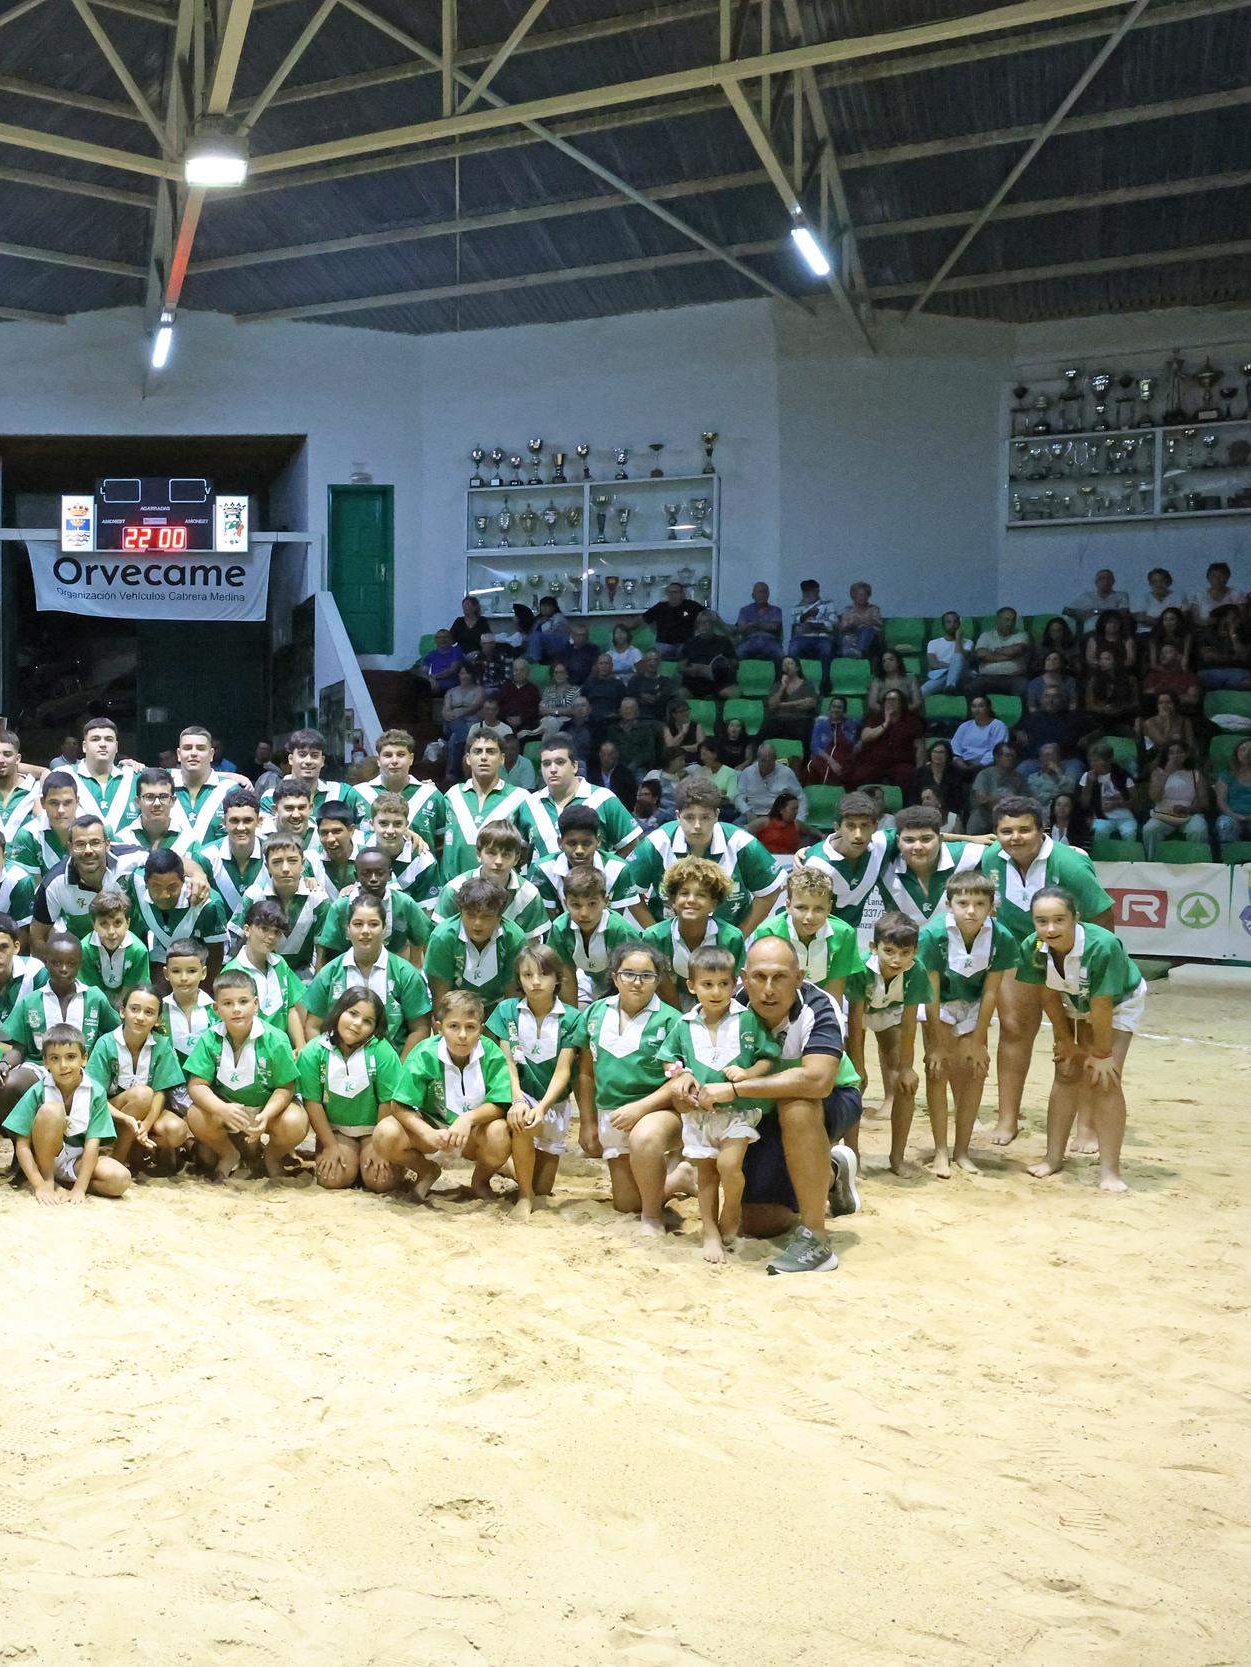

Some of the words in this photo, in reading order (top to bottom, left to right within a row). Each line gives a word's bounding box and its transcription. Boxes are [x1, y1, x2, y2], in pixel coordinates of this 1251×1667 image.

[204, 487, 211, 495] V
[52, 556, 247, 587] Orvecame
[56, 587, 117, 601] Organización
[118, 589, 166, 602] Vehículos
[168, 590, 208, 602] Cabrera
[210, 590, 246, 602] Medina
